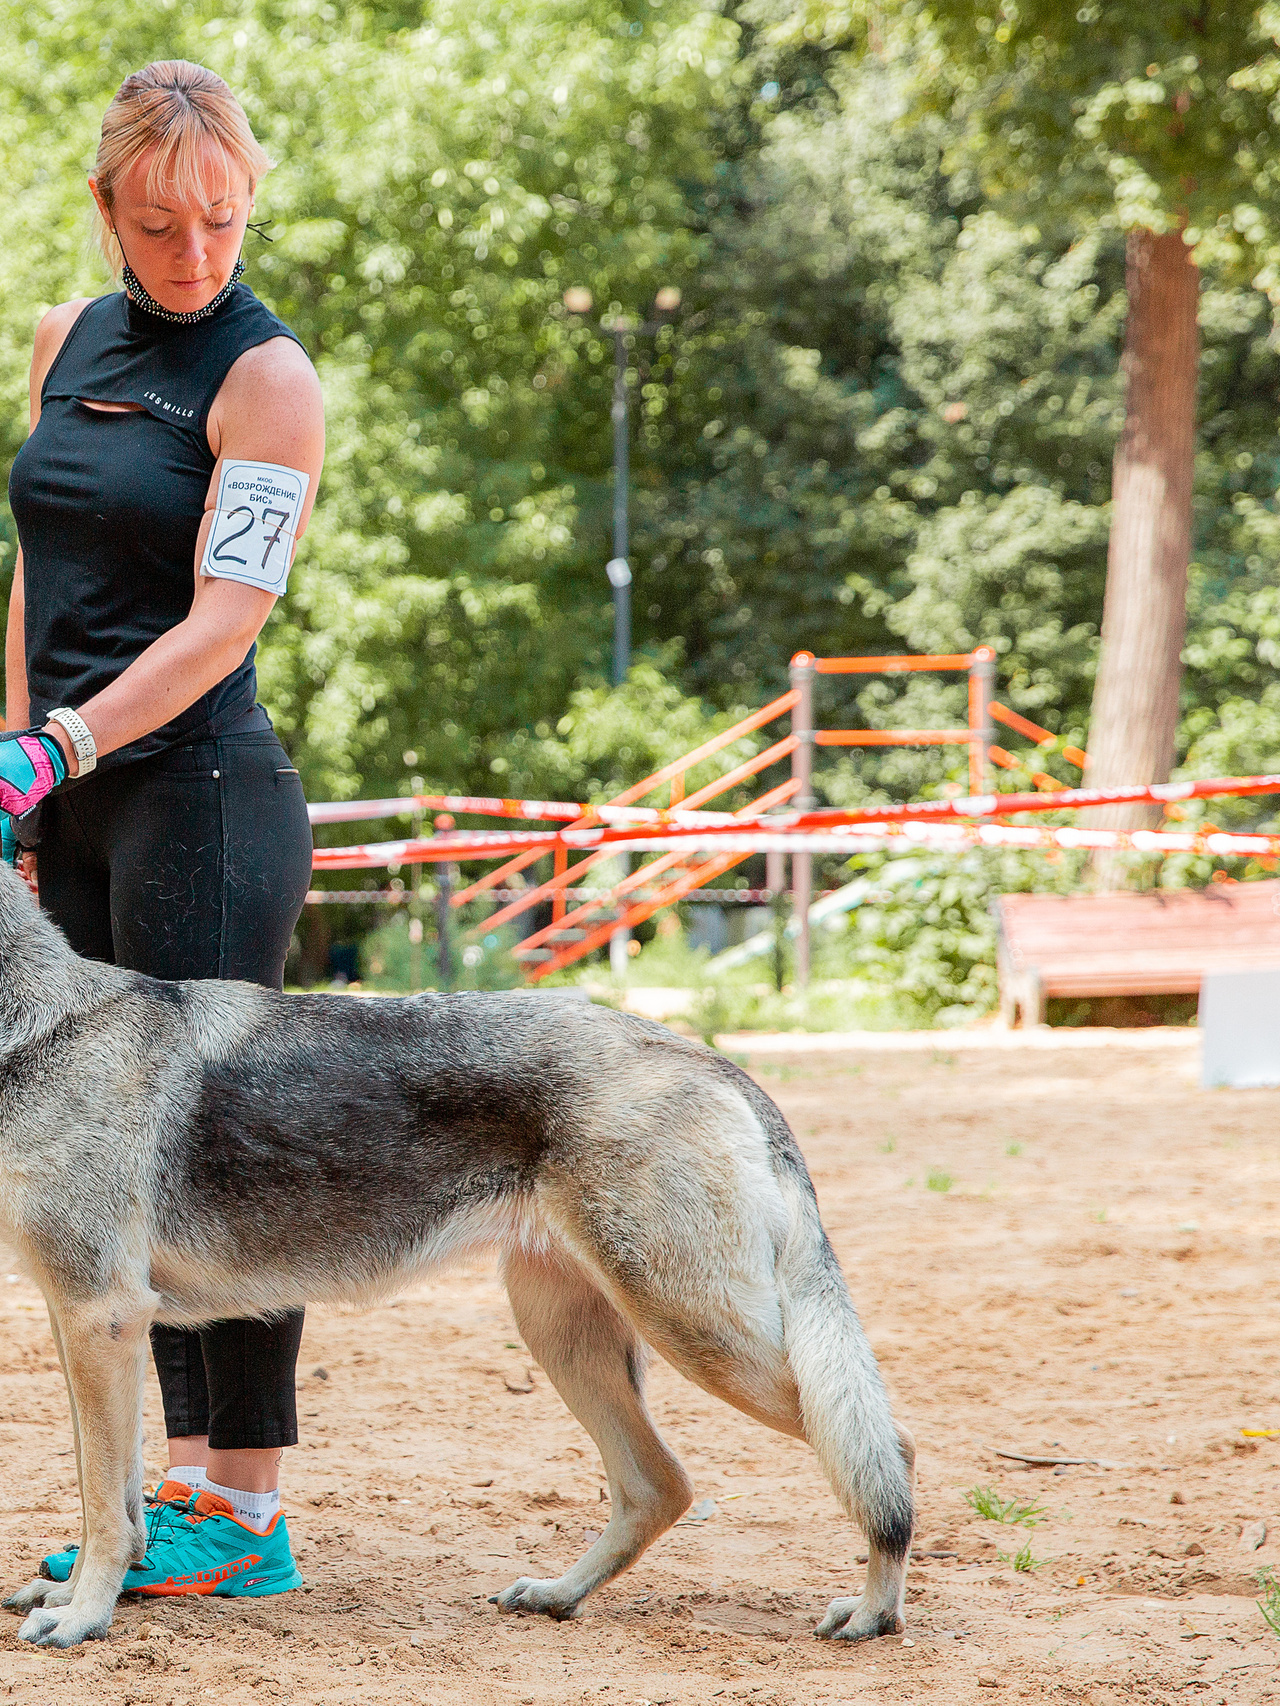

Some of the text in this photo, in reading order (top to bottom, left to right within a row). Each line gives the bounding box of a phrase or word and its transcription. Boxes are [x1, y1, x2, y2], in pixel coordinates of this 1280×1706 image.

[162, 401, 194, 418] MILLS
[227, 481, 297, 501] «ВОЗРОЖДЕНИЕ
[249, 493, 273, 505] БИС»
[213, 505, 290, 570] 27
[232, 1506, 265, 1520] SPORT
